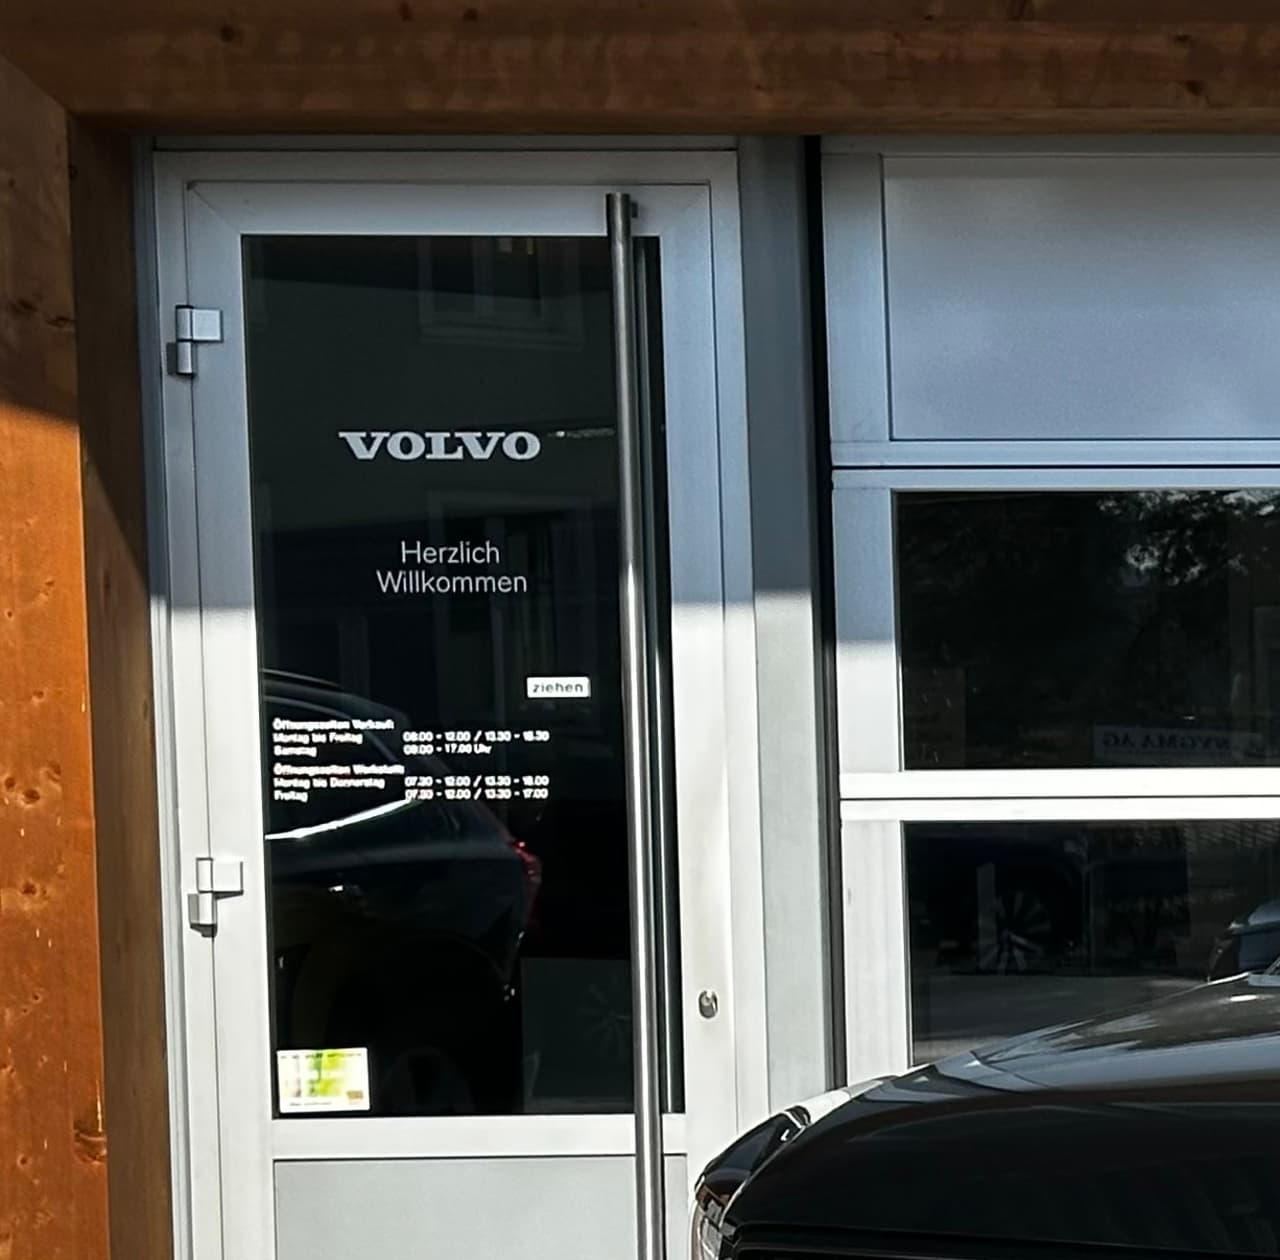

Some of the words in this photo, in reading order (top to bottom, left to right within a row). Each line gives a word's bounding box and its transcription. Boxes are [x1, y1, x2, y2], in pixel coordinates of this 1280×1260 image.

[338, 431, 541, 460] VOLVO
[401, 540, 500, 564] Herzlich
[376, 571, 528, 593] Willkommen
[532, 681, 584, 694] ziehen
